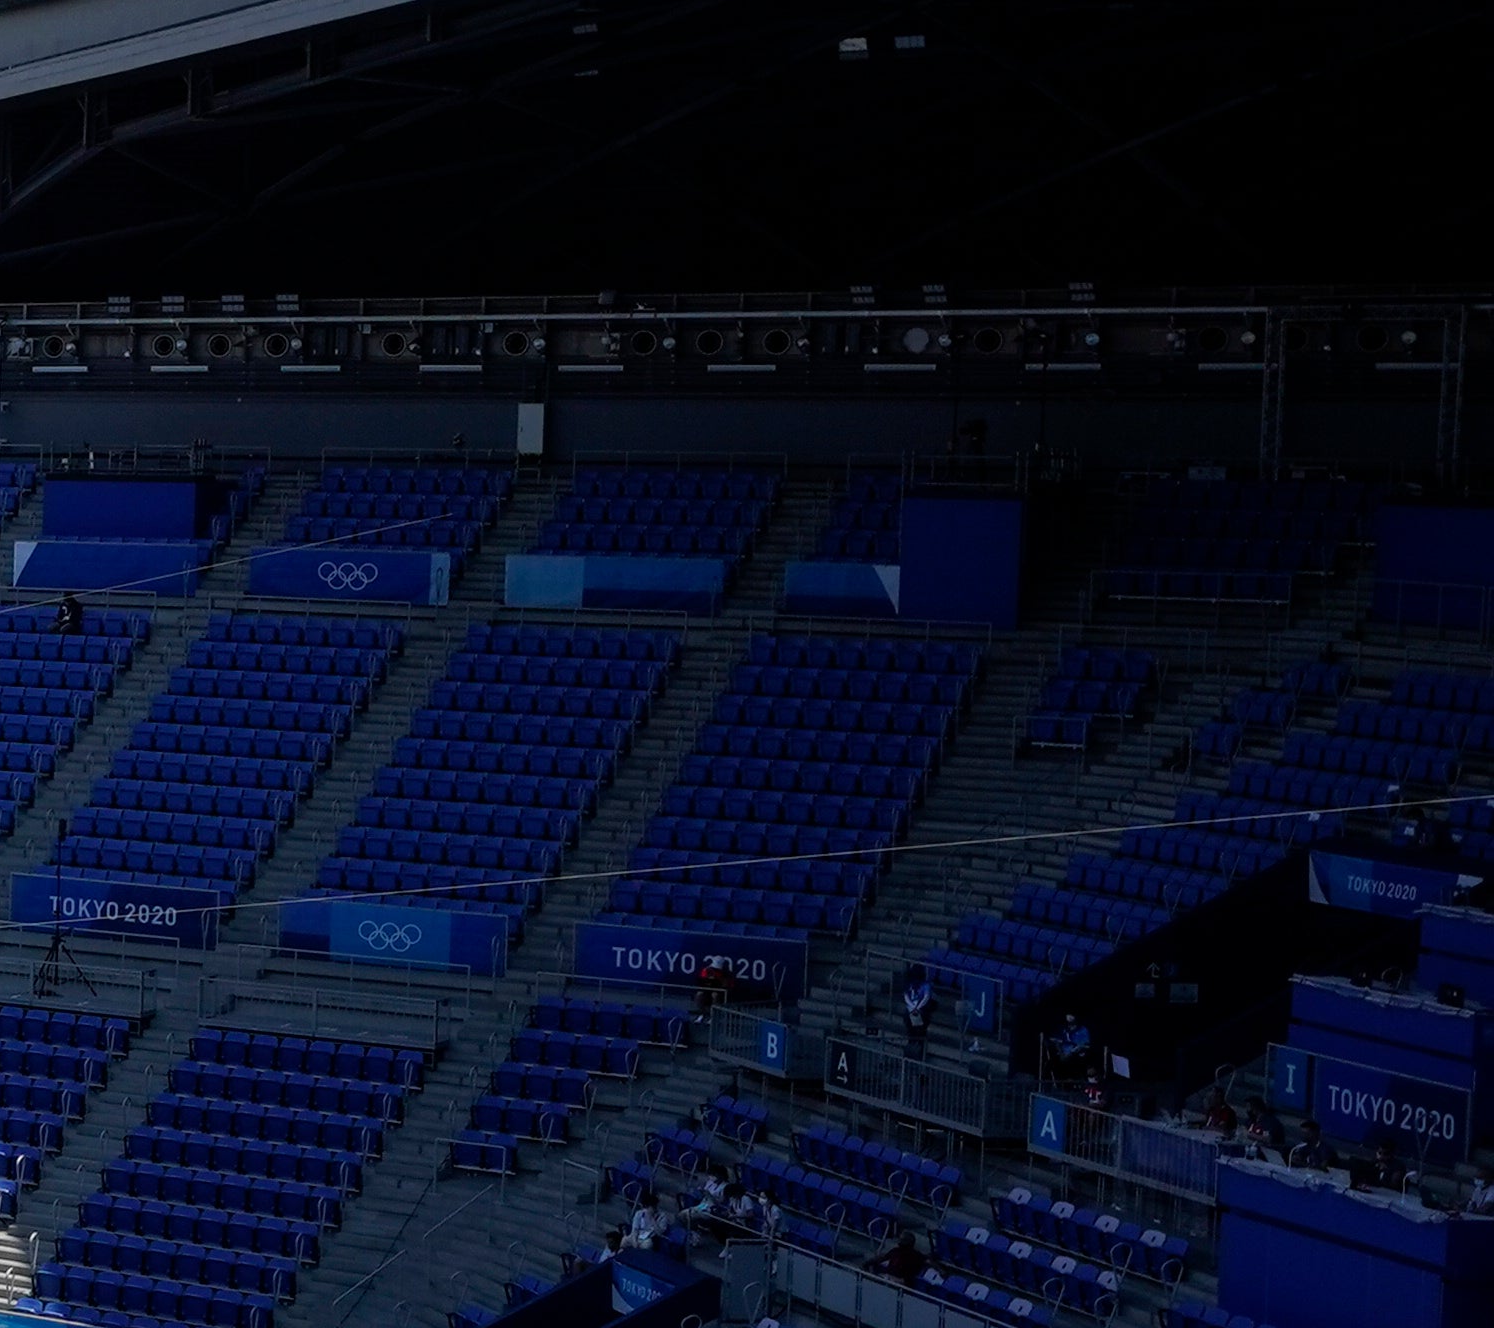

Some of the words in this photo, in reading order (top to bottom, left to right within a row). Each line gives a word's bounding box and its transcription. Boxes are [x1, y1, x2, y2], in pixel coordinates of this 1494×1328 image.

[1347, 876, 1386, 897] TOKYO
[1387, 881, 1418, 902] 2020
[49, 896, 119, 920] TOKYO
[123, 904, 178, 927] 2020
[611, 945, 696, 974] TOKYO
[975, 992, 985, 1017] J
[767, 1033, 778, 1058] B
[838, 1052, 848, 1072] A
[1327, 1085, 1397, 1126] TOKYO
[1400, 1105, 1456, 1139] 2020
[1041, 1111, 1057, 1141] A
